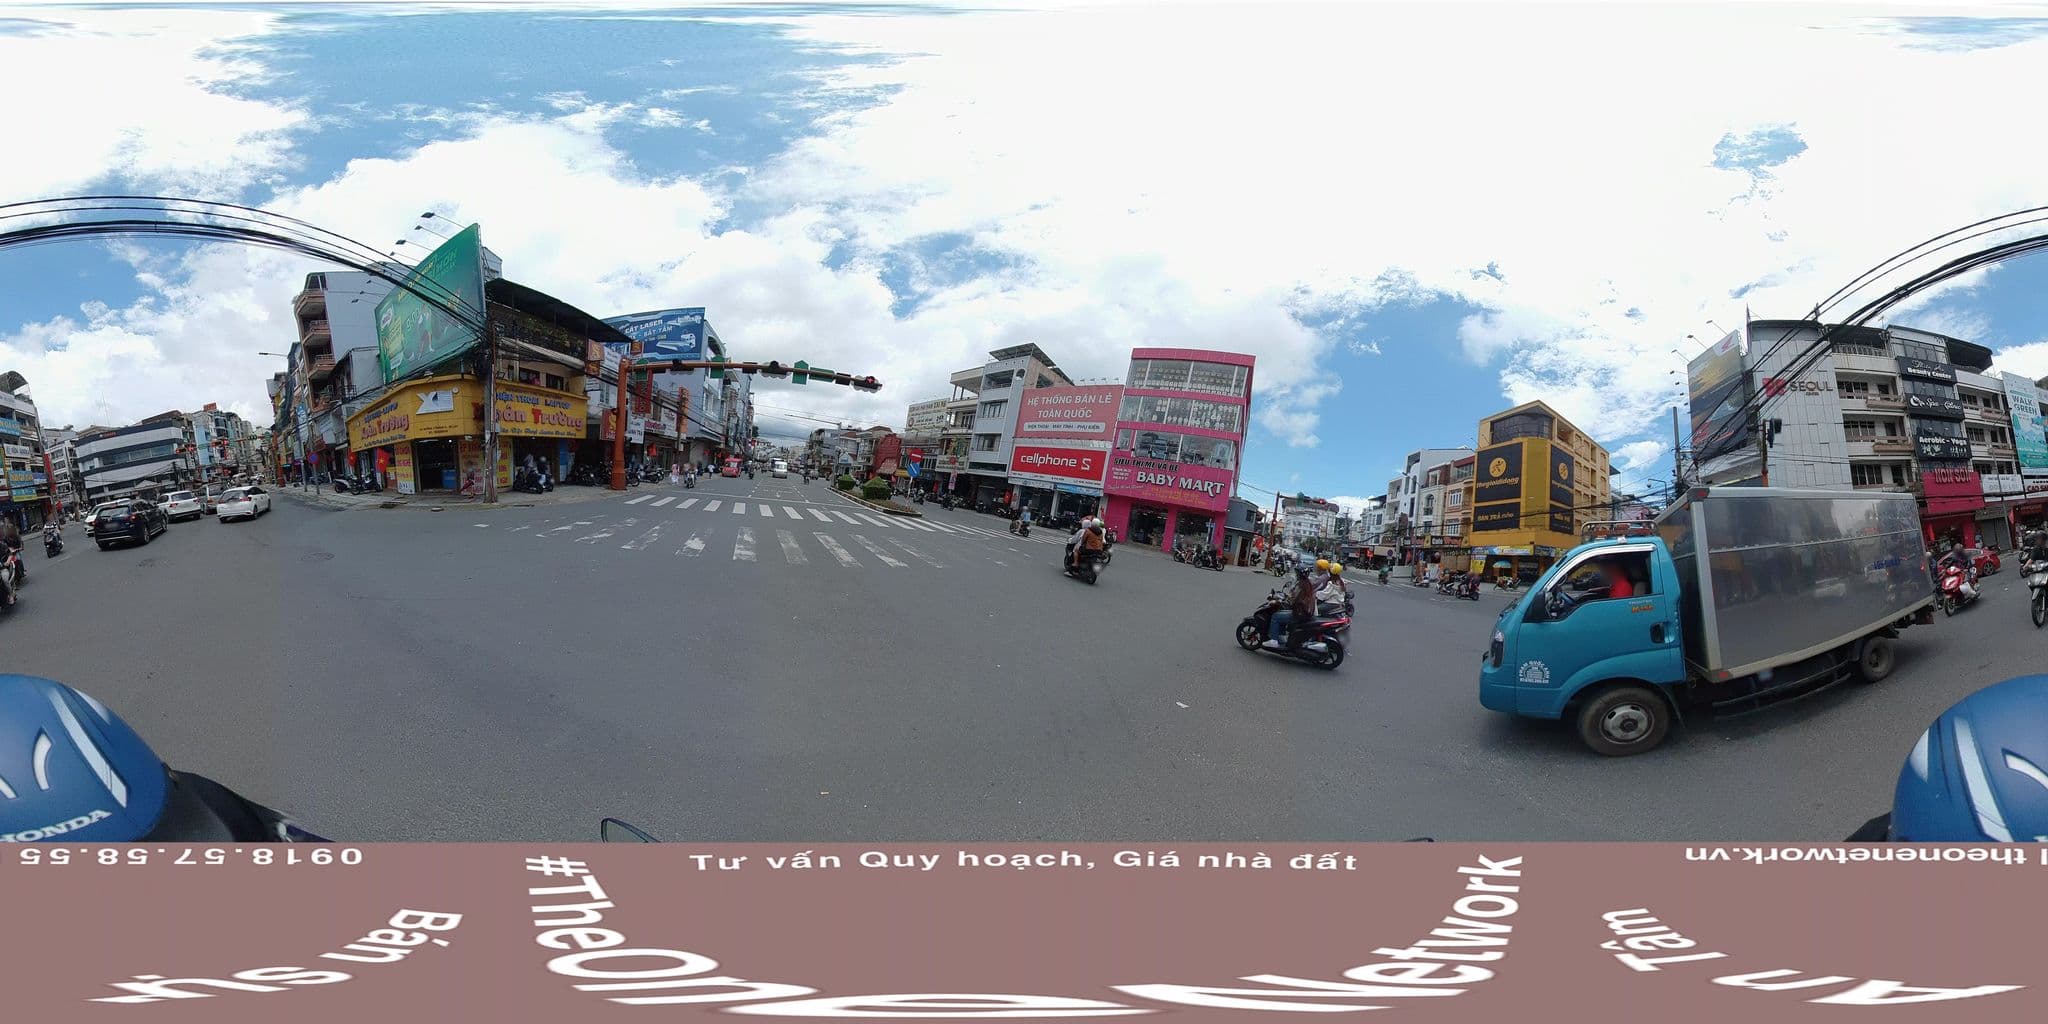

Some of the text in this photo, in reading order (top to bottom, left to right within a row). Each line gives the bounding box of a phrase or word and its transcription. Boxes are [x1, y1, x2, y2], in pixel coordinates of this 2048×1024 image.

[640, 319, 662, 330] LASER
[1790, 381, 1834, 392] SEOUL
[1027, 392, 1113, 406] HỆ THỐNG BÁN LẺ
[2012, 395, 2033, 406] WALK
[1038, 406, 1093, 418] TOÀN QUỐC
[2014, 404, 2037, 416] GREEN
[532, 405, 583, 432] Trường
[1920, 436, 1946, 444] Aerobic
[1020, 452, 1077, 467] cellphone
[1136, 471, 1177, 487] BABY
[1179, 477, 1225, 497] MART
